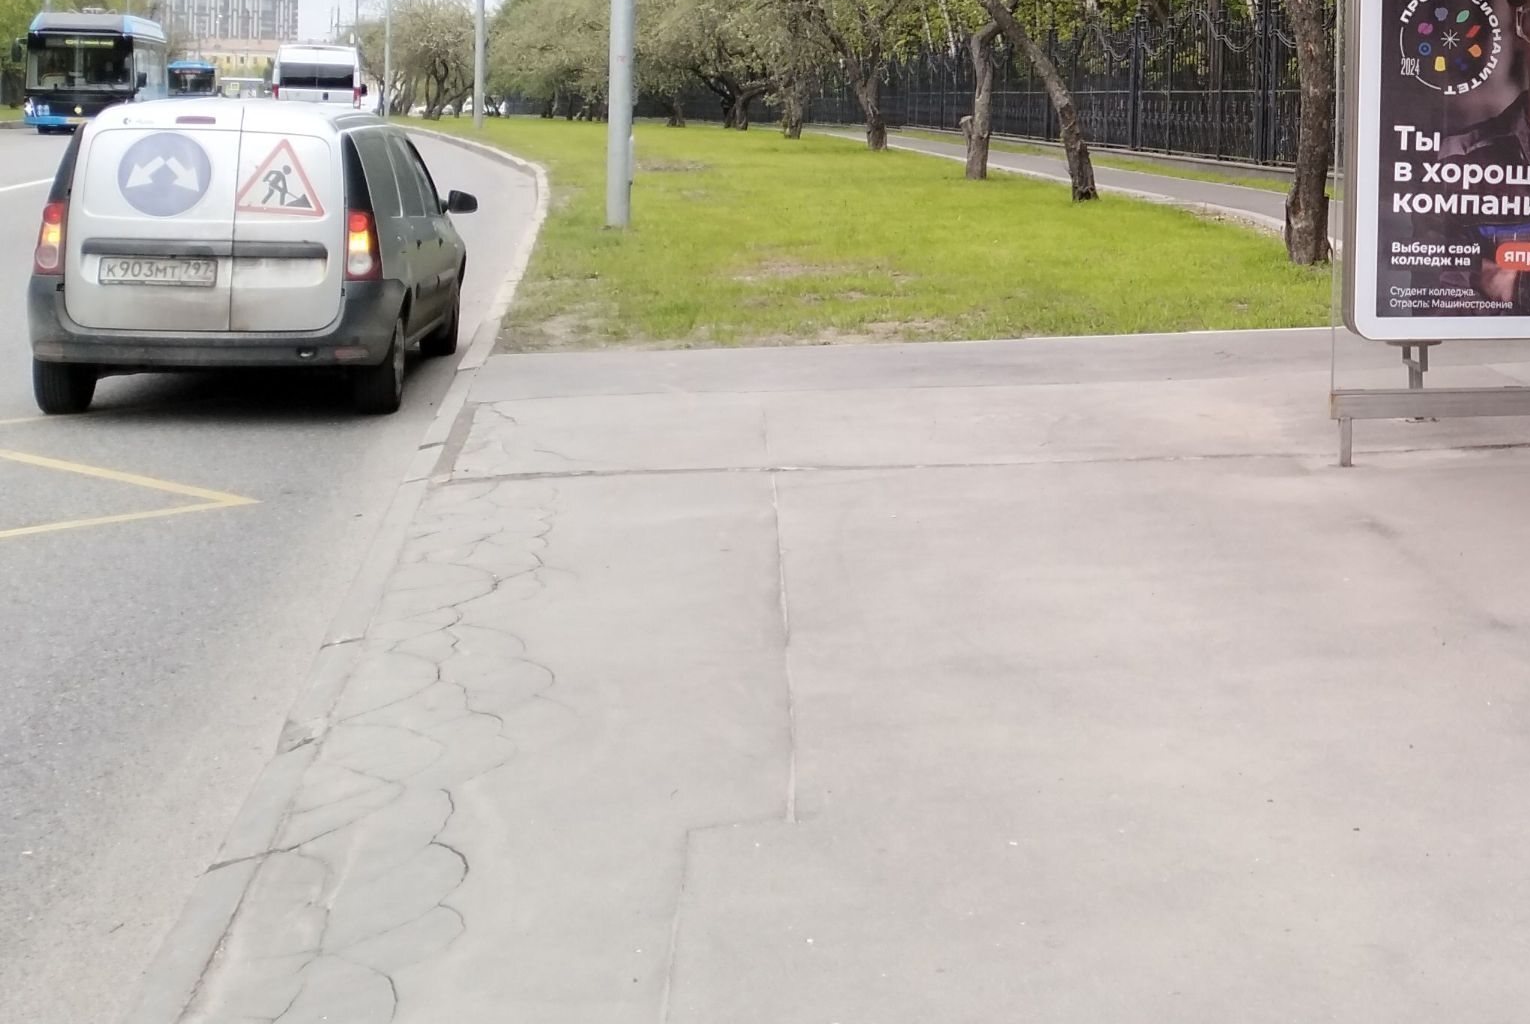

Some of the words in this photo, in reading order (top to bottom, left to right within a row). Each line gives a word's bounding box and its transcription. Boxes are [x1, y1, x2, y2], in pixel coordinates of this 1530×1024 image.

[1400, 57, 1420, 76] 2024
[1394, 125, 1441, 152] Ты
[1394, 162, 1412, 182] в
[1391, 242, 1446, 255] Выбери
[1448, 242, 1481, 255] свой
[1391, 256, 1452, 267] колледж
[1454, 257, 1471, 267] на
[1390, 286, 1427, 298] Студент
[1429, 288, 1476, 298] колледжа.
[1390, 298, 1430, 310] Отрасль:
[1431, 299, 1514, 310] Машиностроение
